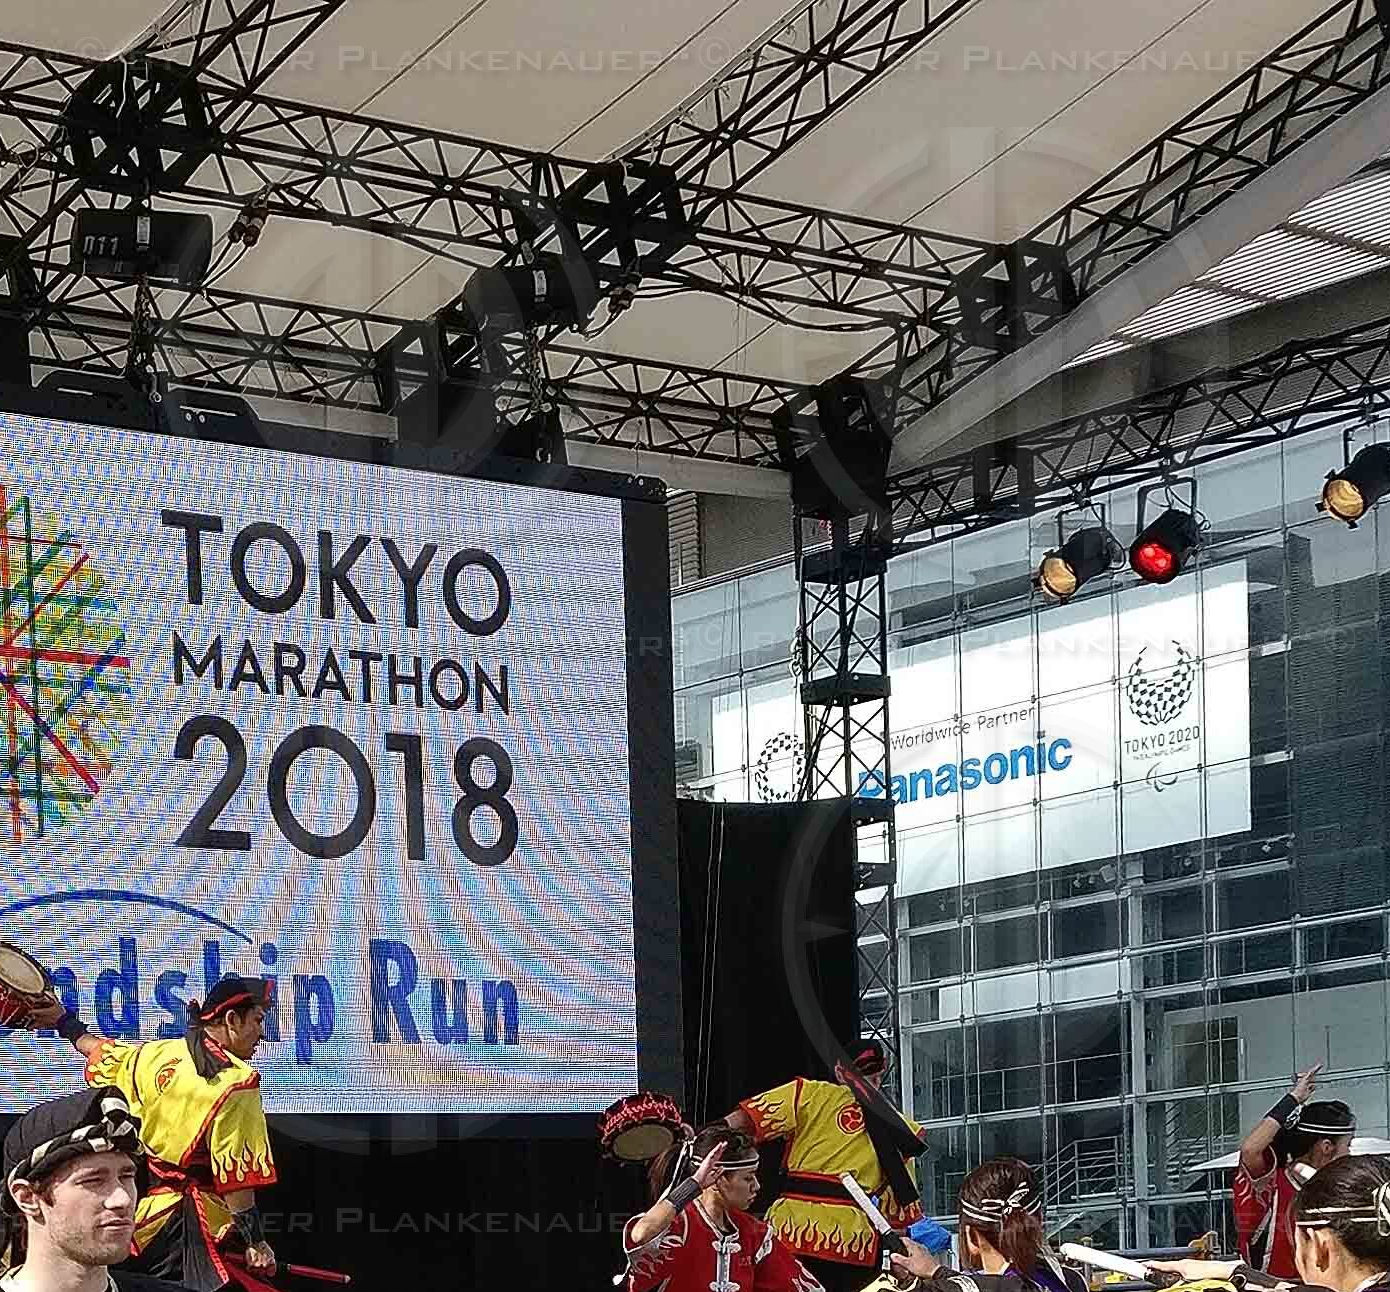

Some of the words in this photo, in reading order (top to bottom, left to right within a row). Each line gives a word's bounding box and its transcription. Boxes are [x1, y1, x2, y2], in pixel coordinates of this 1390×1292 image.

[161, 508, 511, 636] TOKYO
[173, 630, 510, 715] MARATHON
[891, 721, 971, 751] Worldwide
[977, 706, 1035, 731] Partner
[1124, 733, 1165, 755] TOKYO
[1168, 725, 1200, 745] 2020
[174, 714, 519, 866] 2018
[368, 938, 520, 1044] Run
